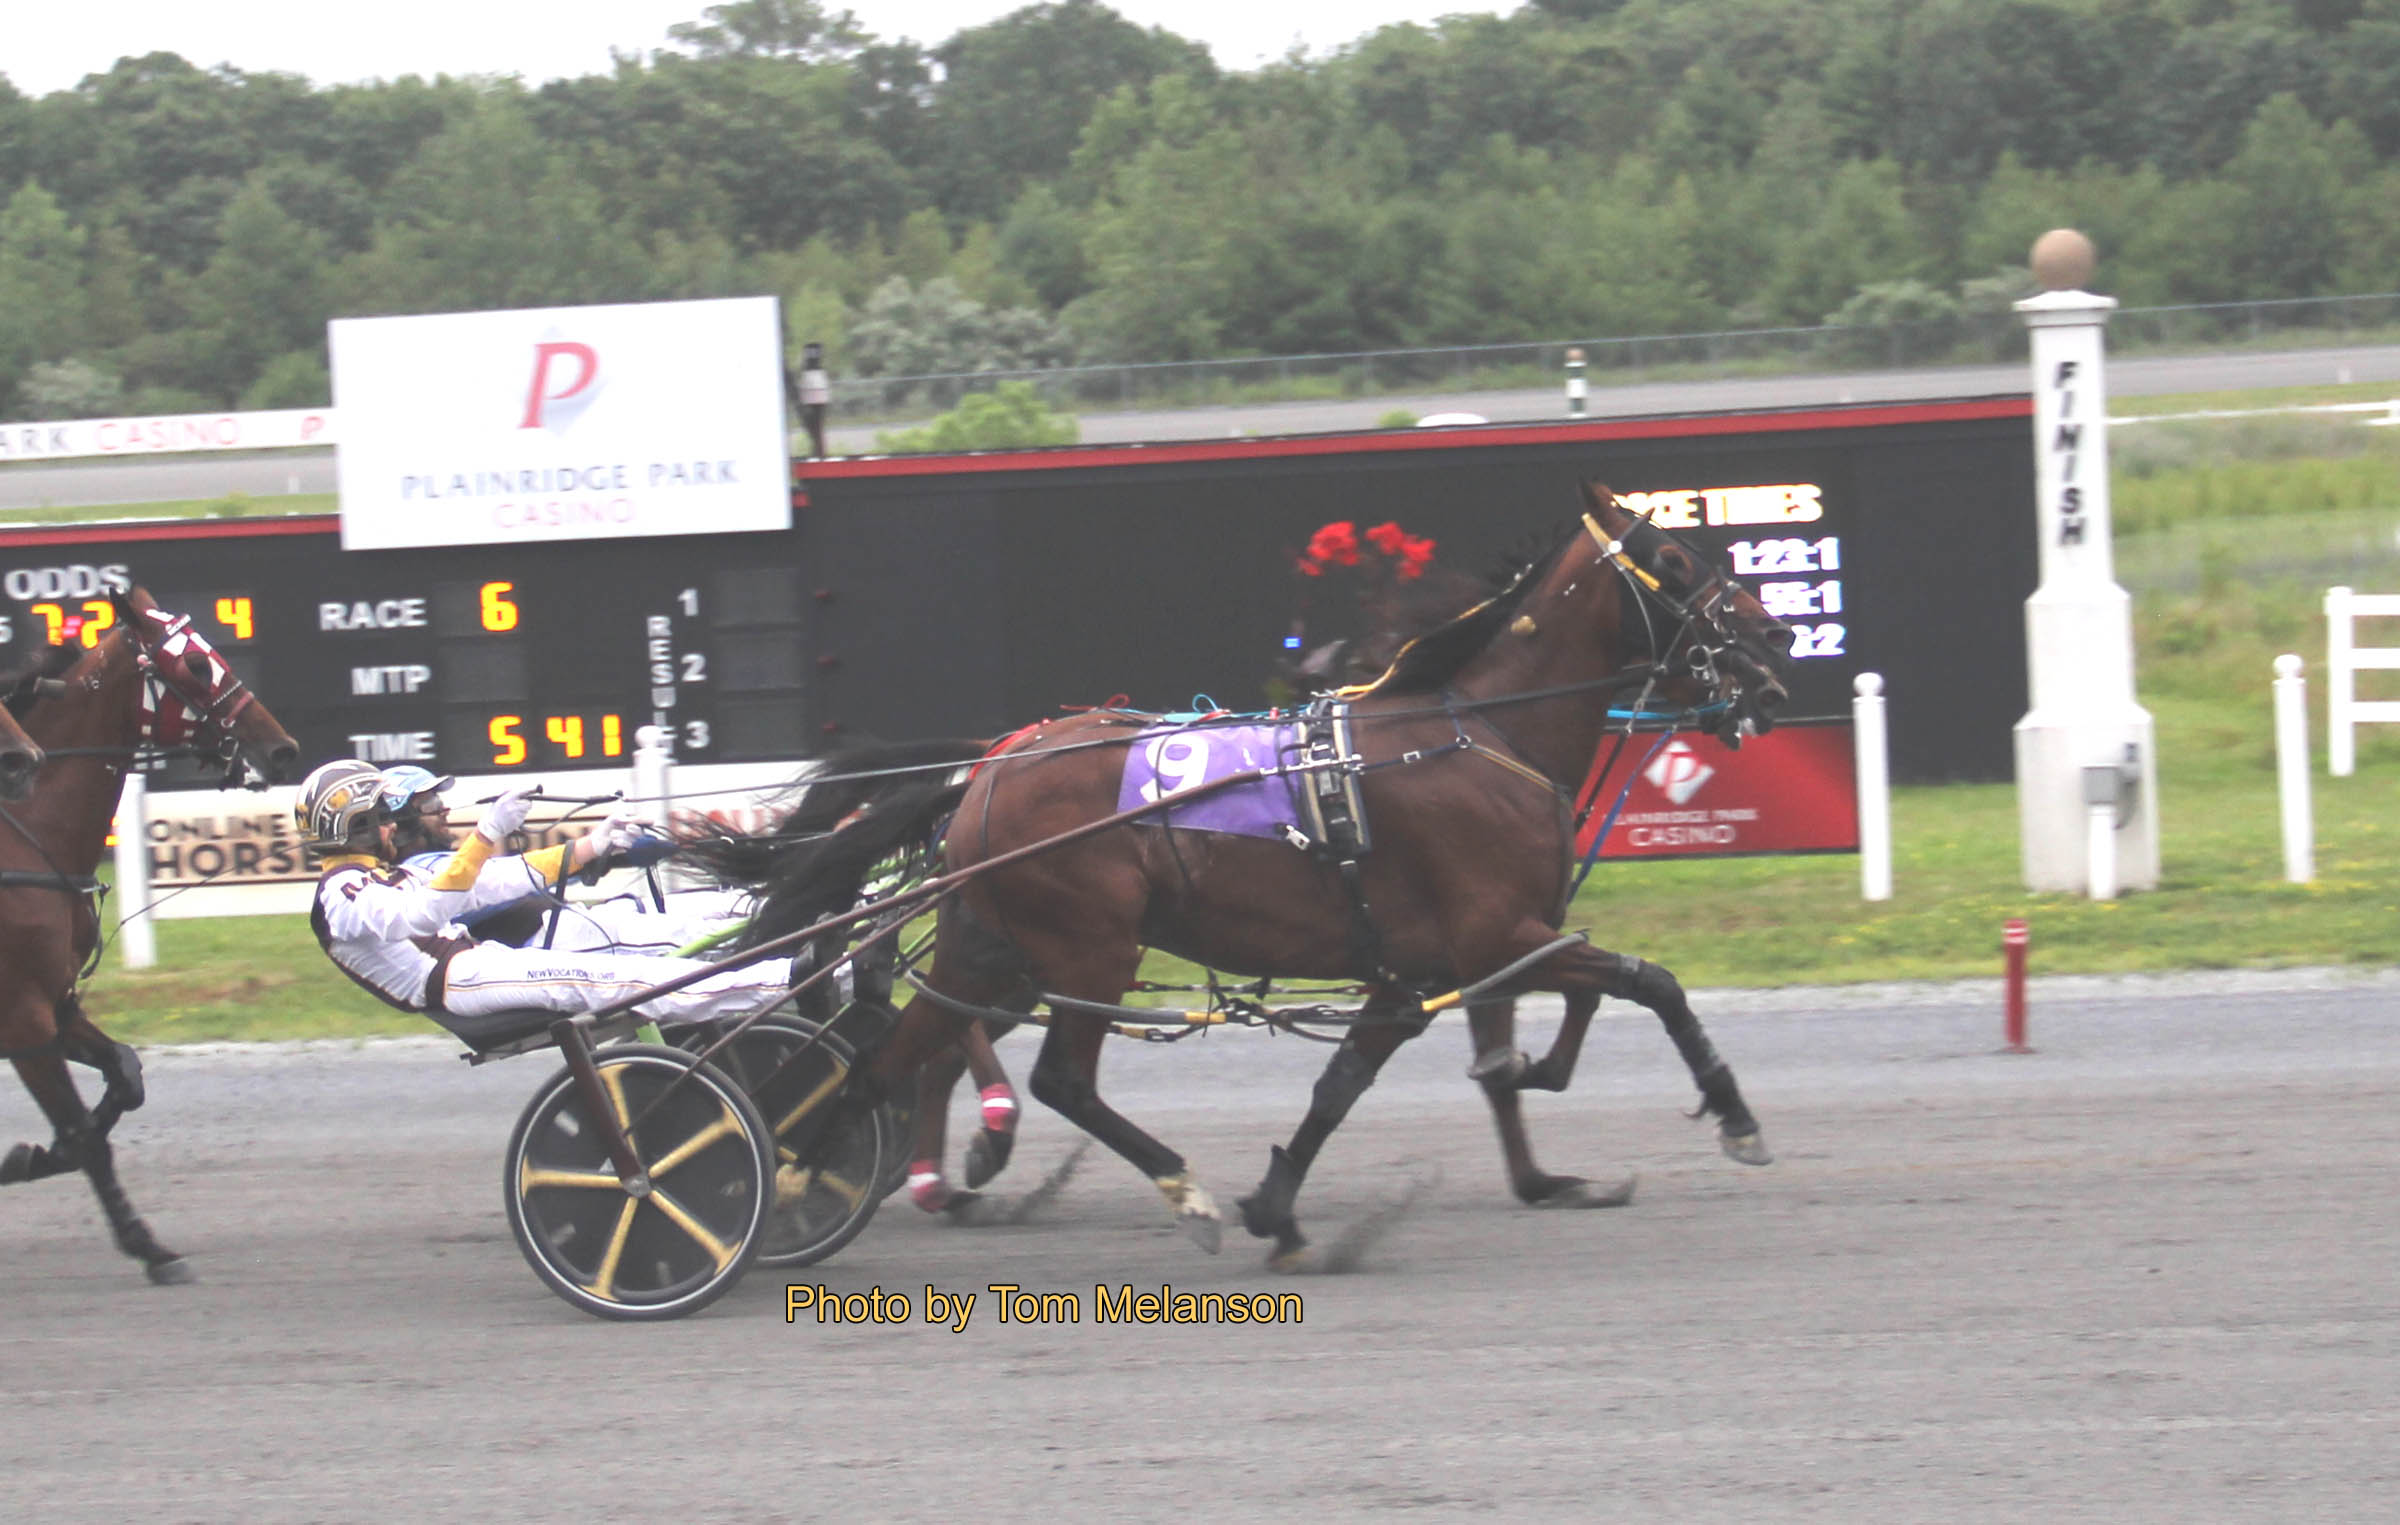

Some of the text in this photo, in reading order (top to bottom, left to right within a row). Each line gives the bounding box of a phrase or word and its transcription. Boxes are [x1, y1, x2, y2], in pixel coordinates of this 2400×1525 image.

[95, 416, 240, 451] CASINO
[2054, 361, 2087, 546] FINISH
[401, 459, 739, 500] PLAINRIDGE PARK
[493, 498, 636, 529] CASINO
[4, 564, 130, 600] ODDS
[215, 597, 254, 639] 4
[319, 581, 519, 632] RACE 6
[678, 588, 699, 617] 1
[351, 664, 432, 695] MTP
[680, 653, 707, 682] 2
[348, 731, 436, 762] TIME
[685, 720, 710, 749] 3
[1140, 733, 1209, 803] 9
[144, 813, 287, 843] ONLINE
[1610, 810, 1709, 826] LAINRIDGE
[1628, 824, 1737, 847] CASINO
